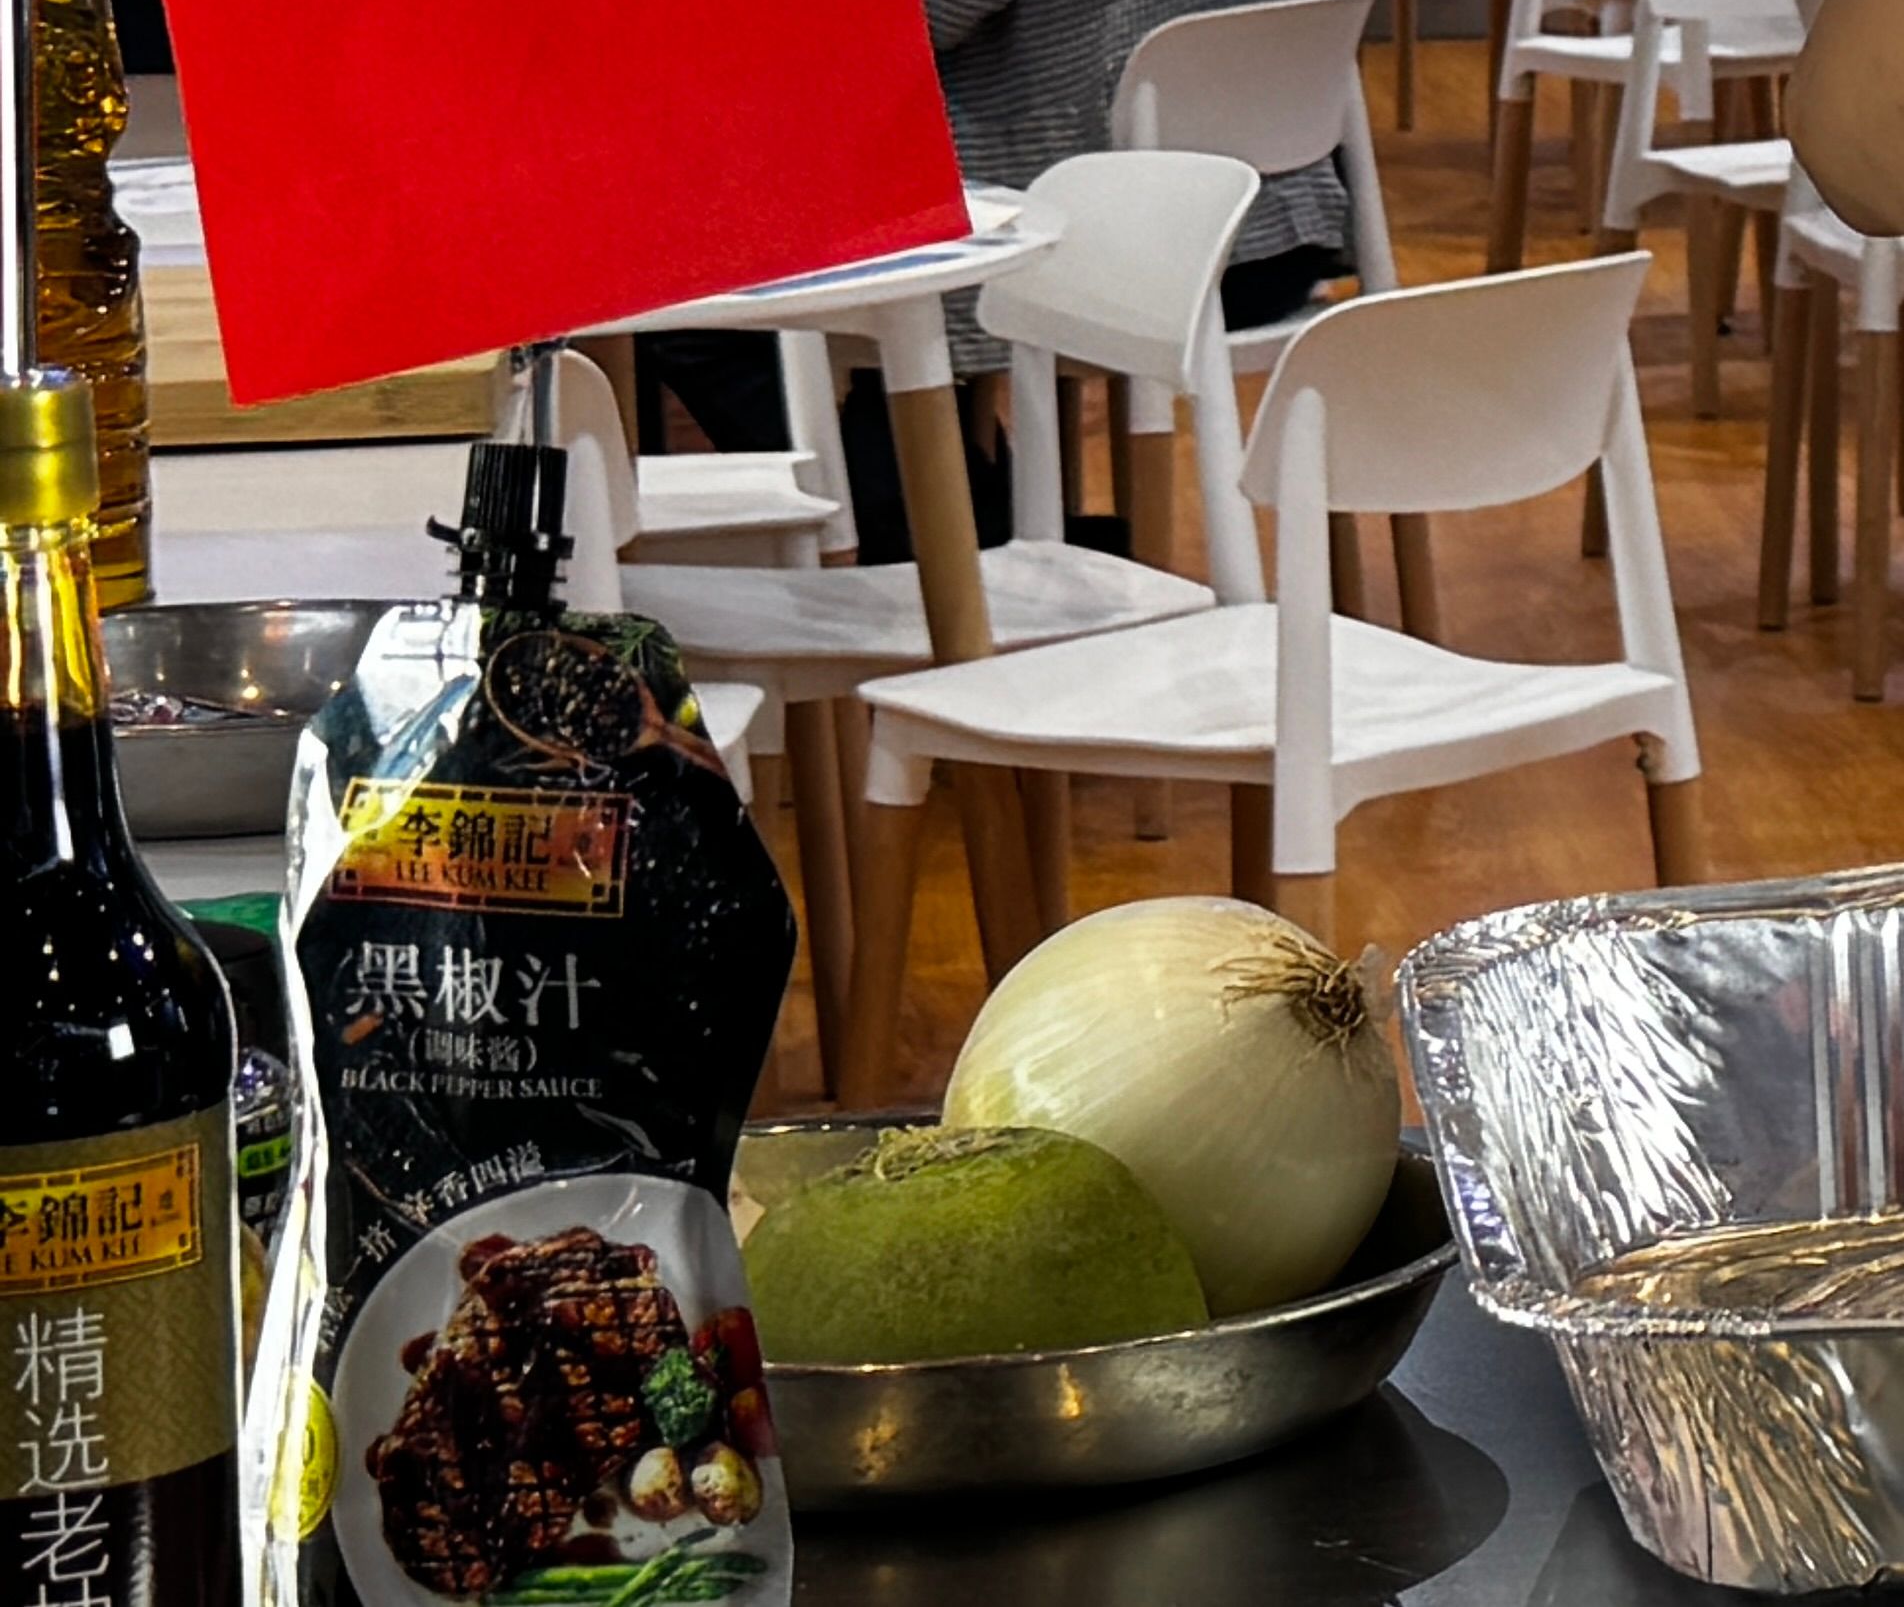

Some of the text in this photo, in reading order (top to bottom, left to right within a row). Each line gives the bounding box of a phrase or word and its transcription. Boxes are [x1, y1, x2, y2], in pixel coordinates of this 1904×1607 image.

[397, 805, 552, 866] 李錦記
[442, 862, 497, 889] KUM
[344, 941, 601, 1030] 黑椒汁
[341, 1066, 603, 1100] BLACK PEPPER SAUCE
